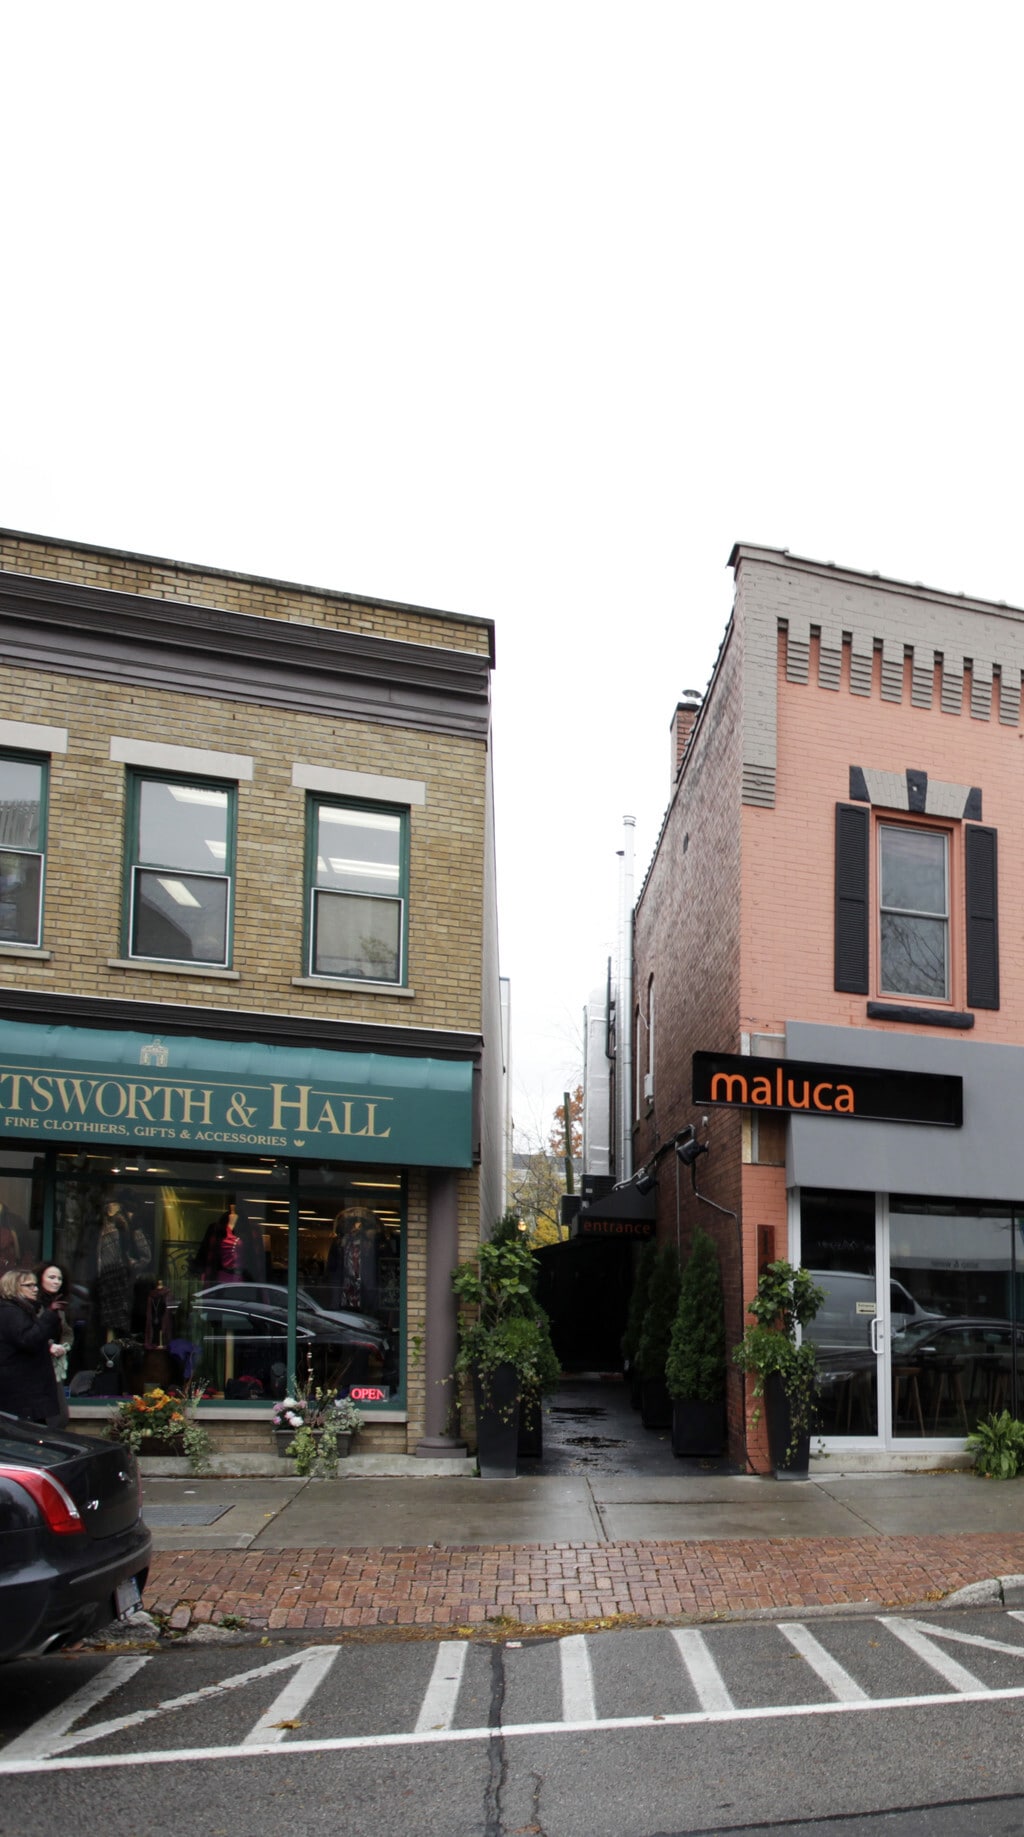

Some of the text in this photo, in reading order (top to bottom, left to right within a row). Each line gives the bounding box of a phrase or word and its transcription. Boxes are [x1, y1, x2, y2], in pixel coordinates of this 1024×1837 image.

[0, 1073, 391, 1138] TSWORTH & HALL
[711, 1067, 855, 1113] maluca
[5, 1116, 288, 1147] FINE CLOTHIERS, GIFTS & ACCESSORIES
[583, 1220, 651, 1234] entrance
[351, 1387, 387, 1400] OPEN
